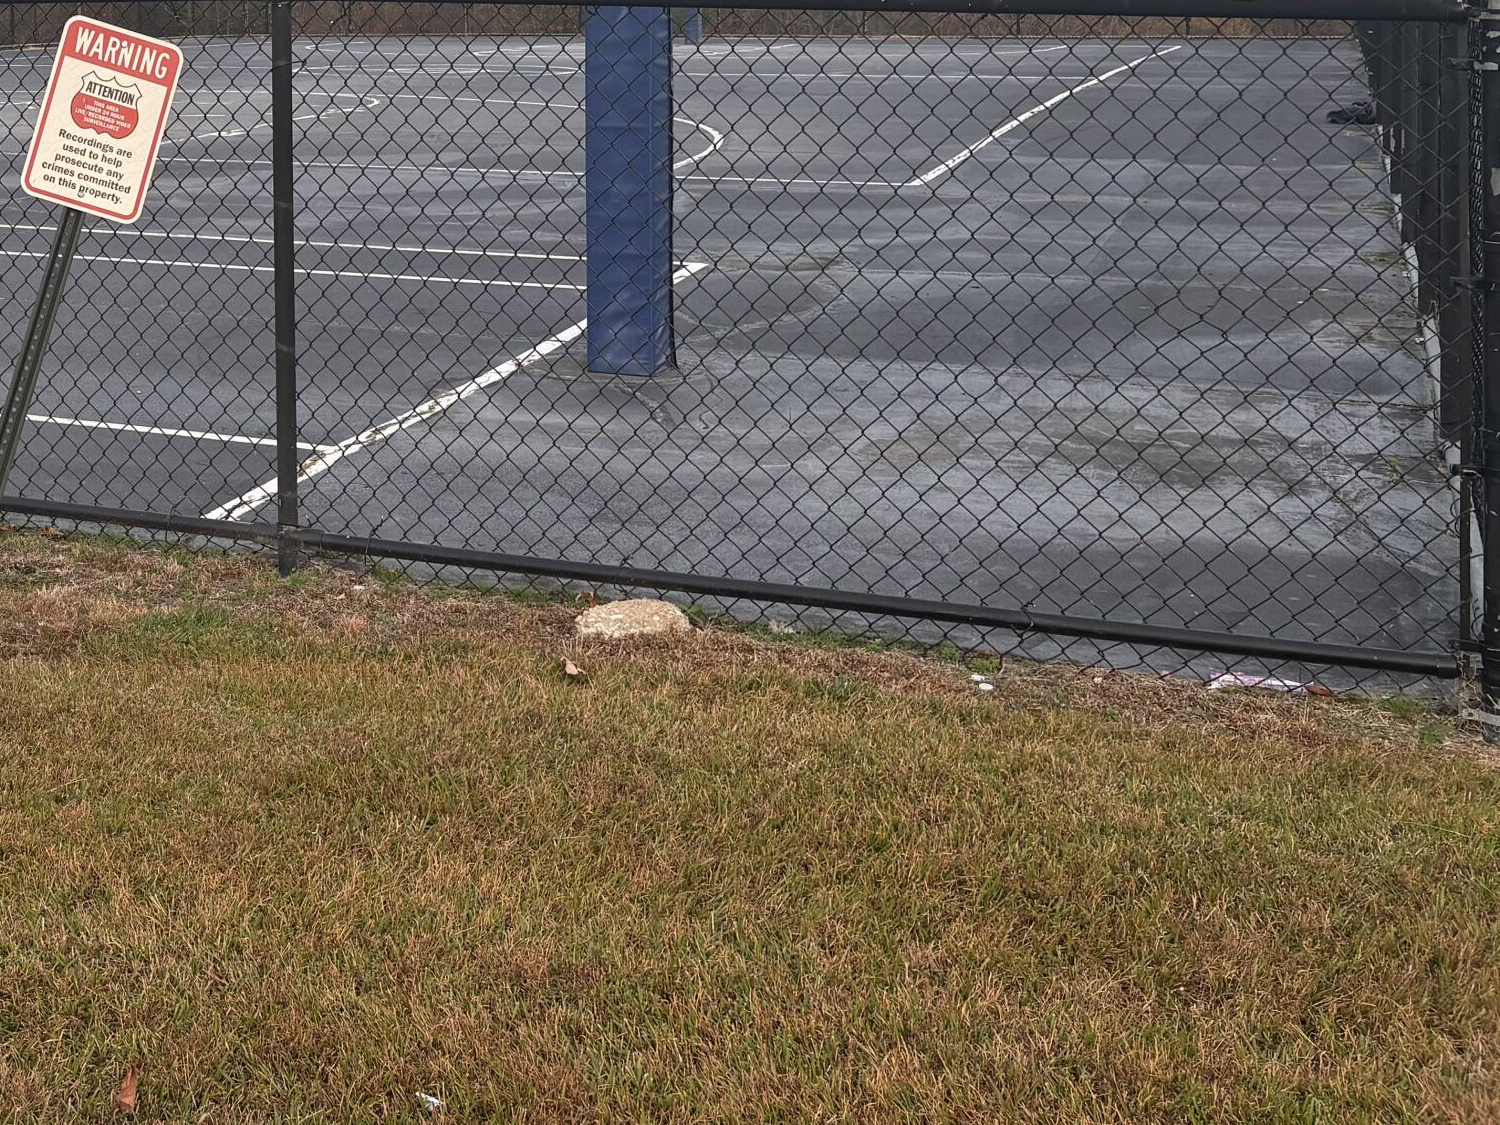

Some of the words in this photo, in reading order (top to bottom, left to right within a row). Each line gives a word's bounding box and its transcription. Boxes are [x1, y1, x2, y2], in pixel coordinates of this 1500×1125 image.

[75, 26, 171, 79] WARNING
[85, 80, 135, 106] ATTENTION
[74, 107, 116, 124] LIVE/RECORDED
[116, 120, 132, 129] VIDEO
[84, 104, 102, 113] UNDER
[110, 112, 125, 121] HOUR
[106, 104, 119, 113] AREA
[83, 116, 120, 132] SURVEILLANCE
[58, 128, 114, 154] Recordings
[116, 148, 133, 159] are
[62, 143, 87, 156] used
[89, 150, 99, 160] to
[101, 154, 123, 168] help
[41, 161, 75, 177] crimes
[77, 172, 132, 194] committed
[54, 153, 104, 174] prosecute
[106, 169, 125, 181] any
[43, 173, 56, 183] on
[58, 177, 77, 190] this
[78, 184, 123, 205] property.
